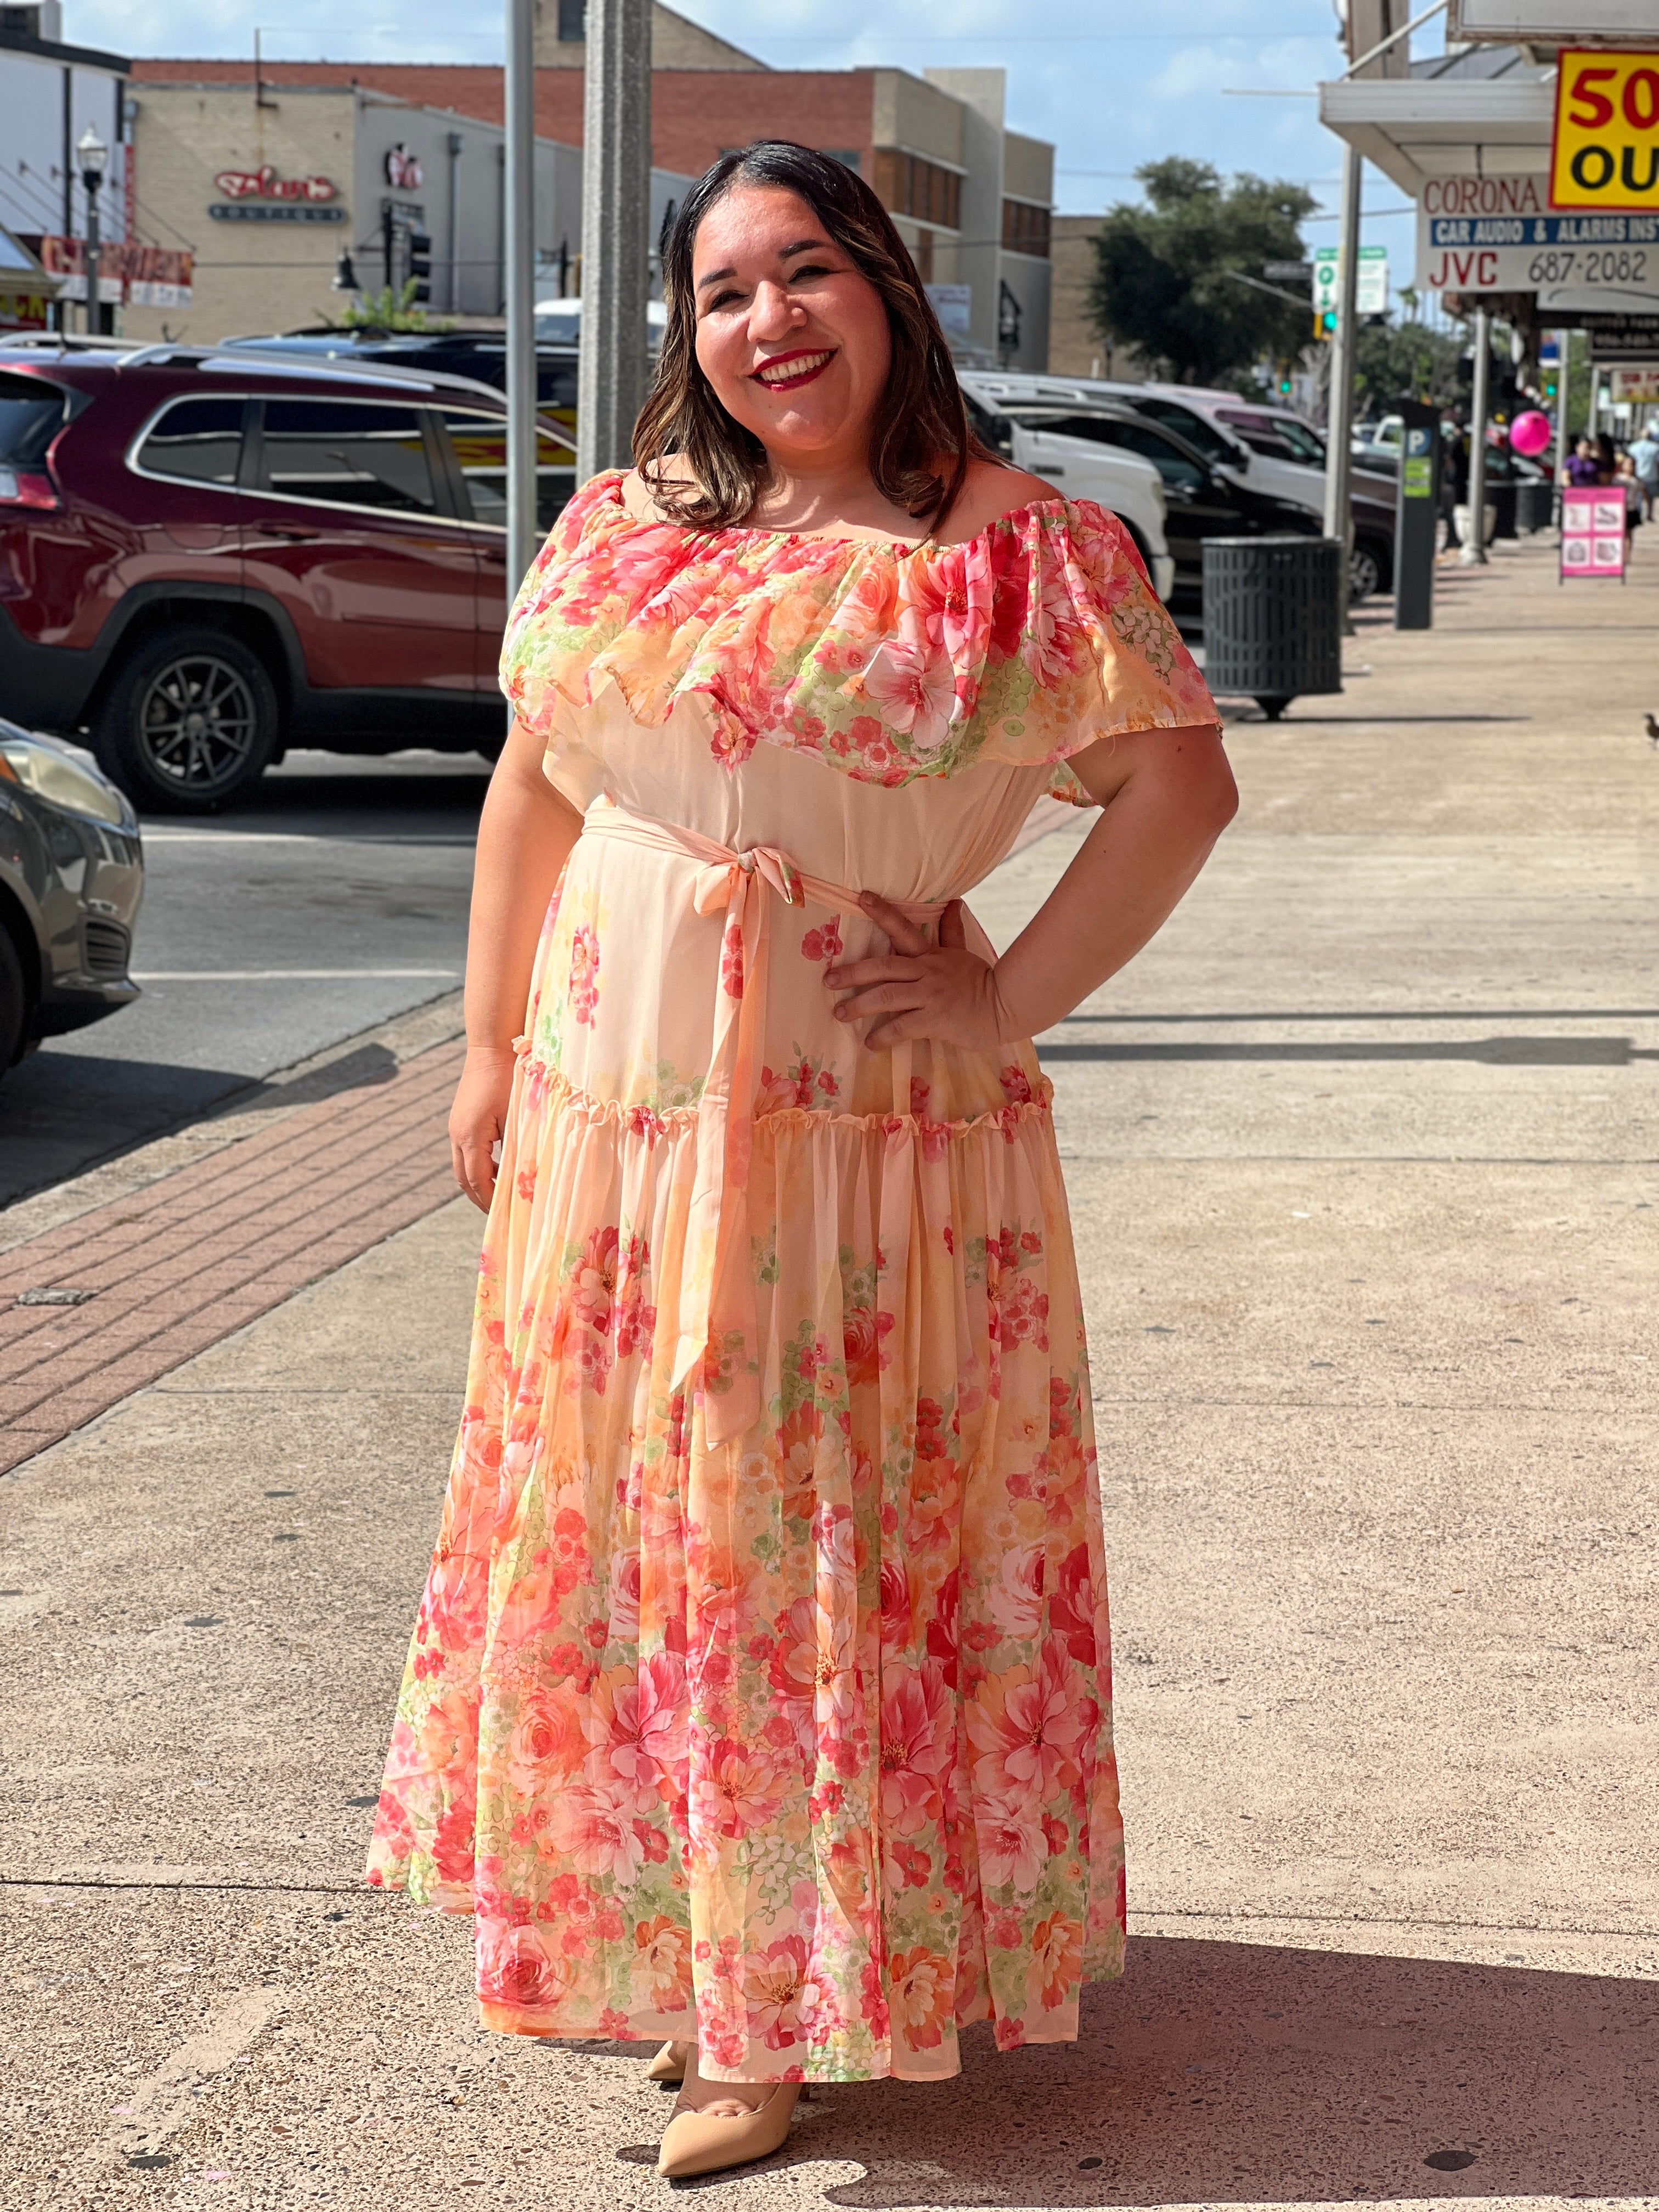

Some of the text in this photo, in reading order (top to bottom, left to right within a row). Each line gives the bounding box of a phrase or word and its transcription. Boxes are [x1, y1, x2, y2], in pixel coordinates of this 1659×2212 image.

[1569, 69, 1659, 129] 50
[1424, 178, 1541, 214] CORONA
[1435, 216, 1659, 243] CAR AUDIO & ALARMS INS
[1429, 251, 1498, 287] JVC
[1408, 429, 1426, 455] P
